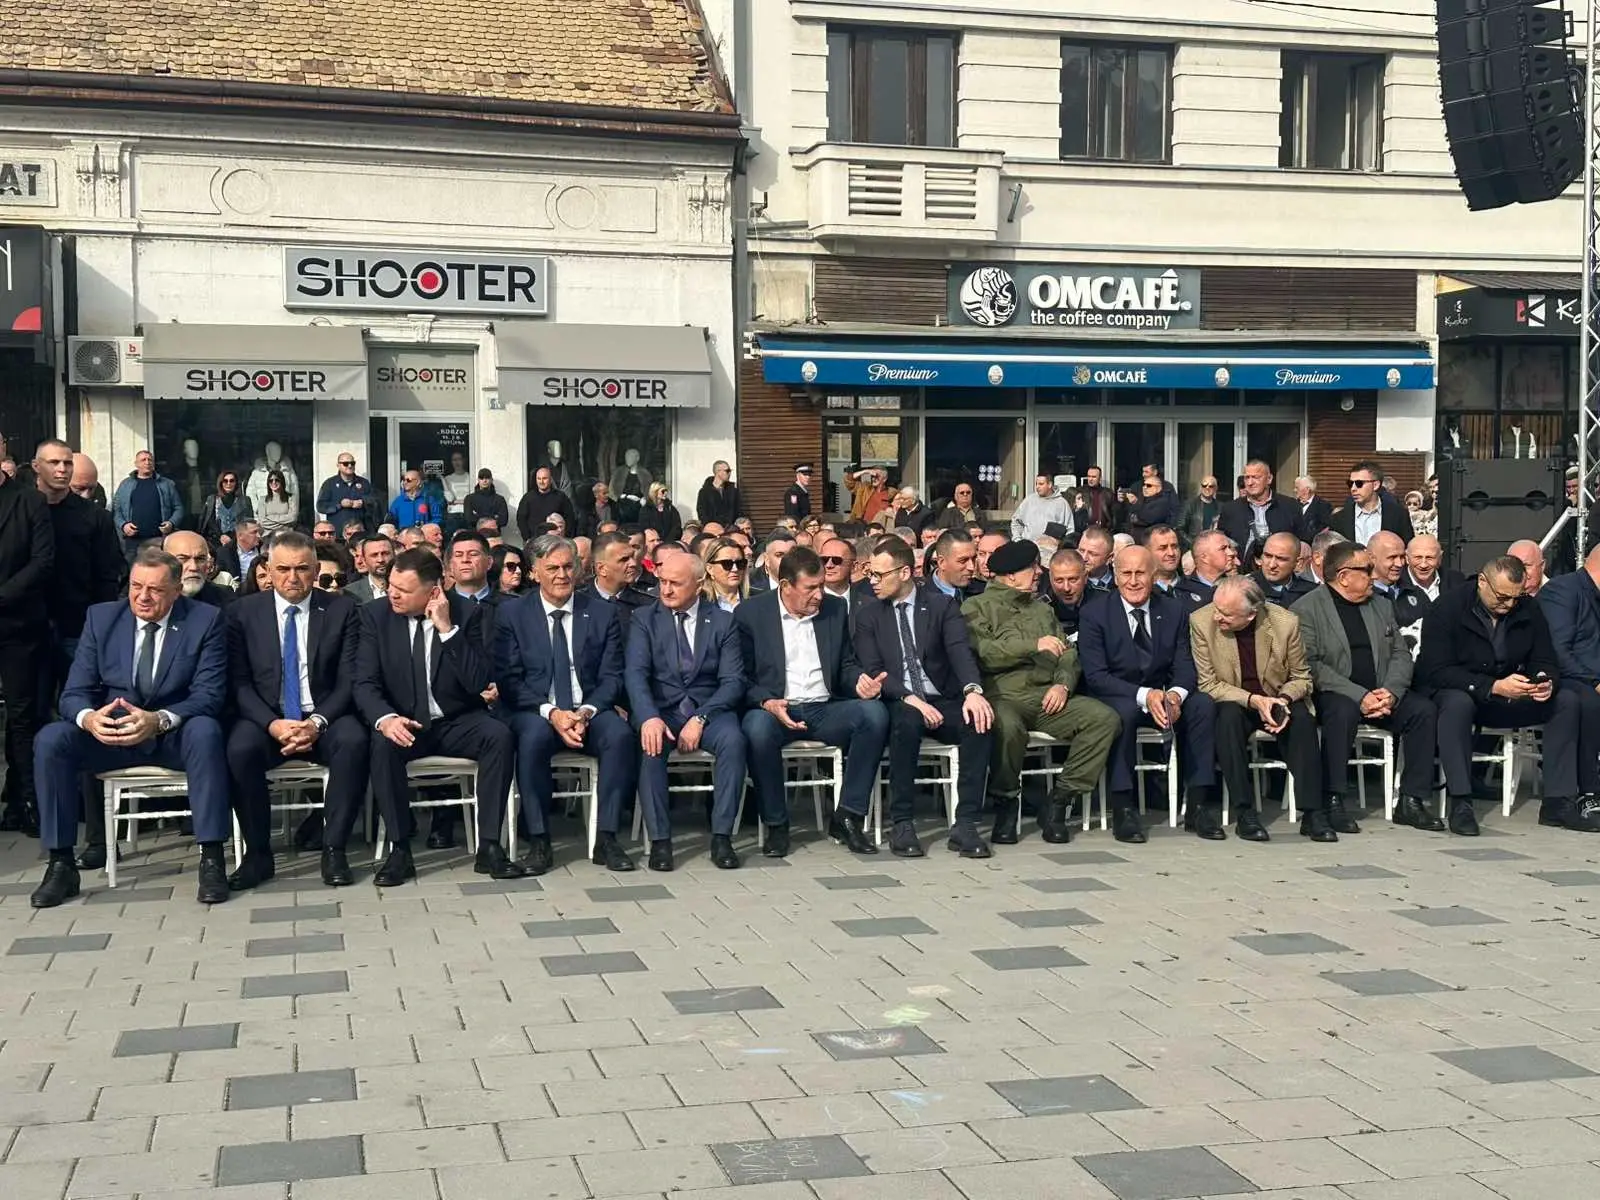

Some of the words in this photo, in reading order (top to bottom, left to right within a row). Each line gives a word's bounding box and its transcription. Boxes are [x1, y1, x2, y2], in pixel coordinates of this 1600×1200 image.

[296, 257, 536, 303] SHOOTER
[1030, 309, 1055, 325] the
[1059, 311, 1103, 326] coffee
[1106, 314, 1171, 330] company
[186, 369, 326, 393] SHOOTER
[376, 367, 467, 384] SHOOTER
[867, 363, 938, 382] Premium
[1275, 368, 1341, 386] Premium
[543, 377, 667, 400] SHOOTER
